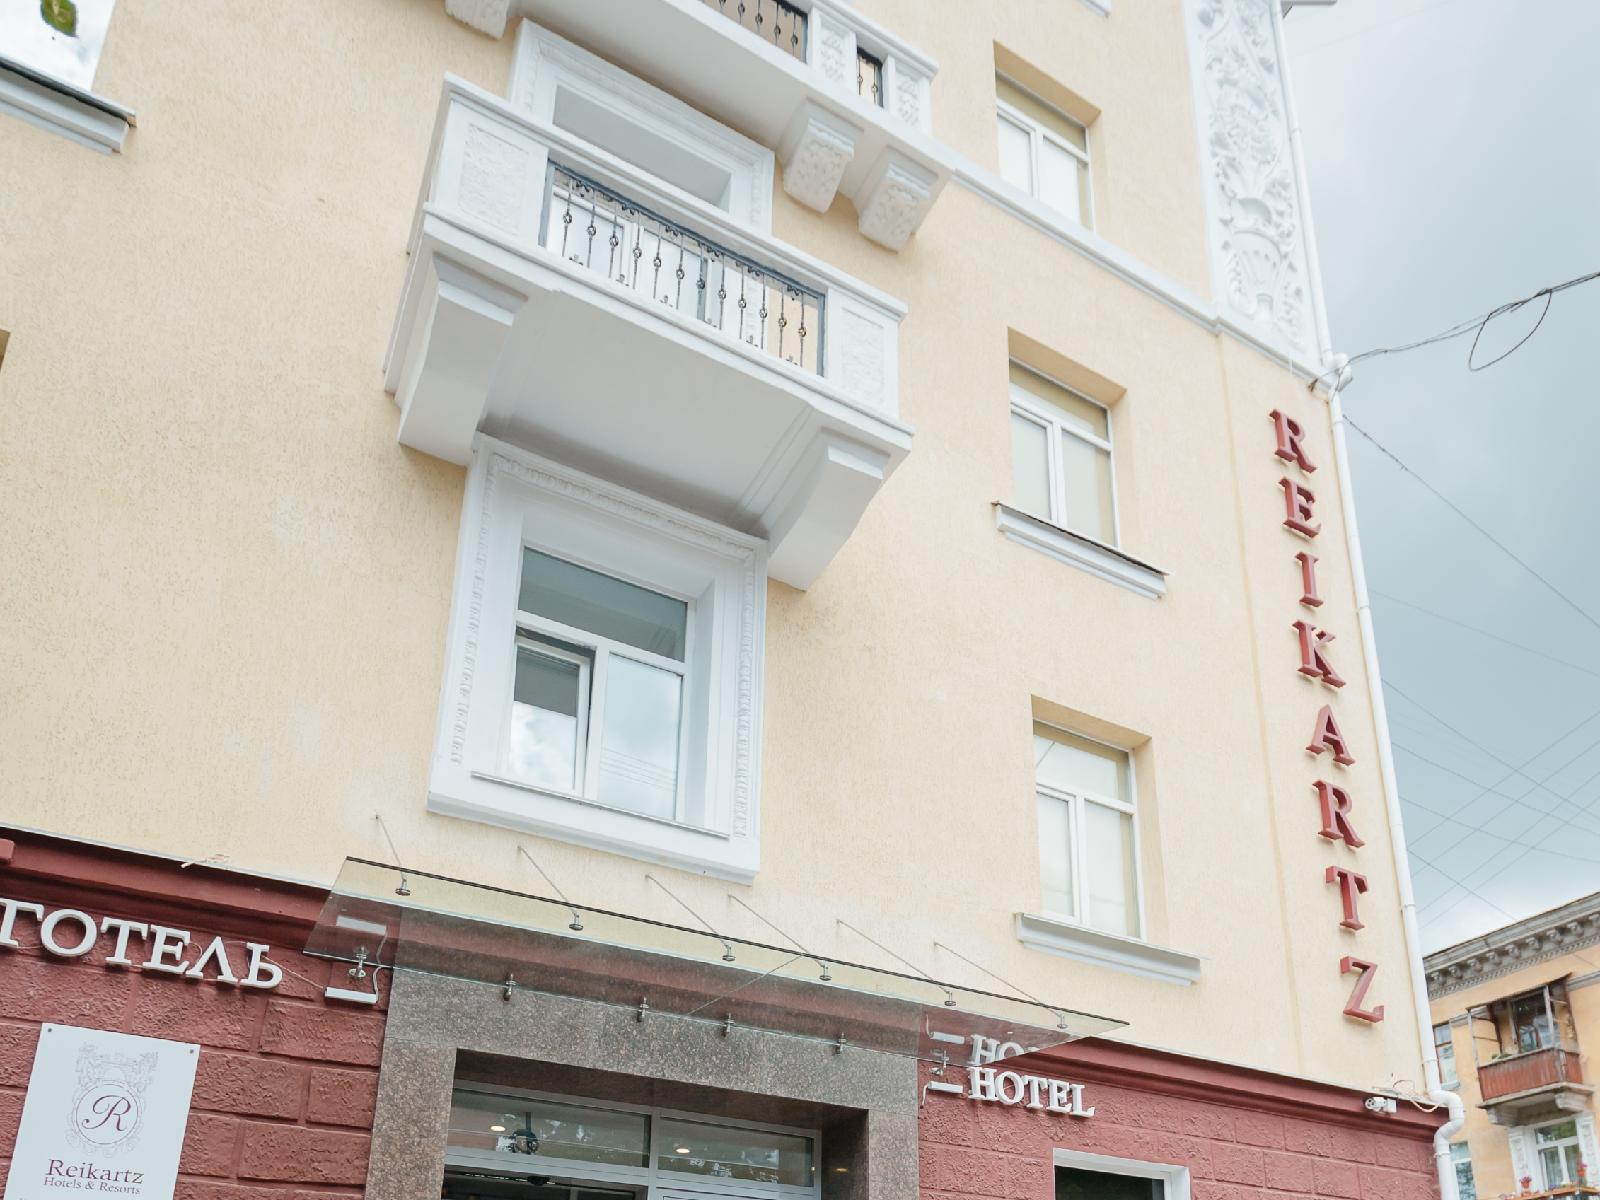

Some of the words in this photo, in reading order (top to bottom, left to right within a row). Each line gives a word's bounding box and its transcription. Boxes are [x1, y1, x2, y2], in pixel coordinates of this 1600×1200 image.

[1269, 408, 1385, 1024] REIKARTZ
[0, 898, 284, 989] ГОТЕЛЬ
[967, 1066, 1096, 1118] HOTEL
[43, 1176, 82, 1189] Hotels
[84, 1182, 95, 1190] &
[99, 1182, 142, 1195] Resorts
[45, 1158, 145, 1184] Reikartz
